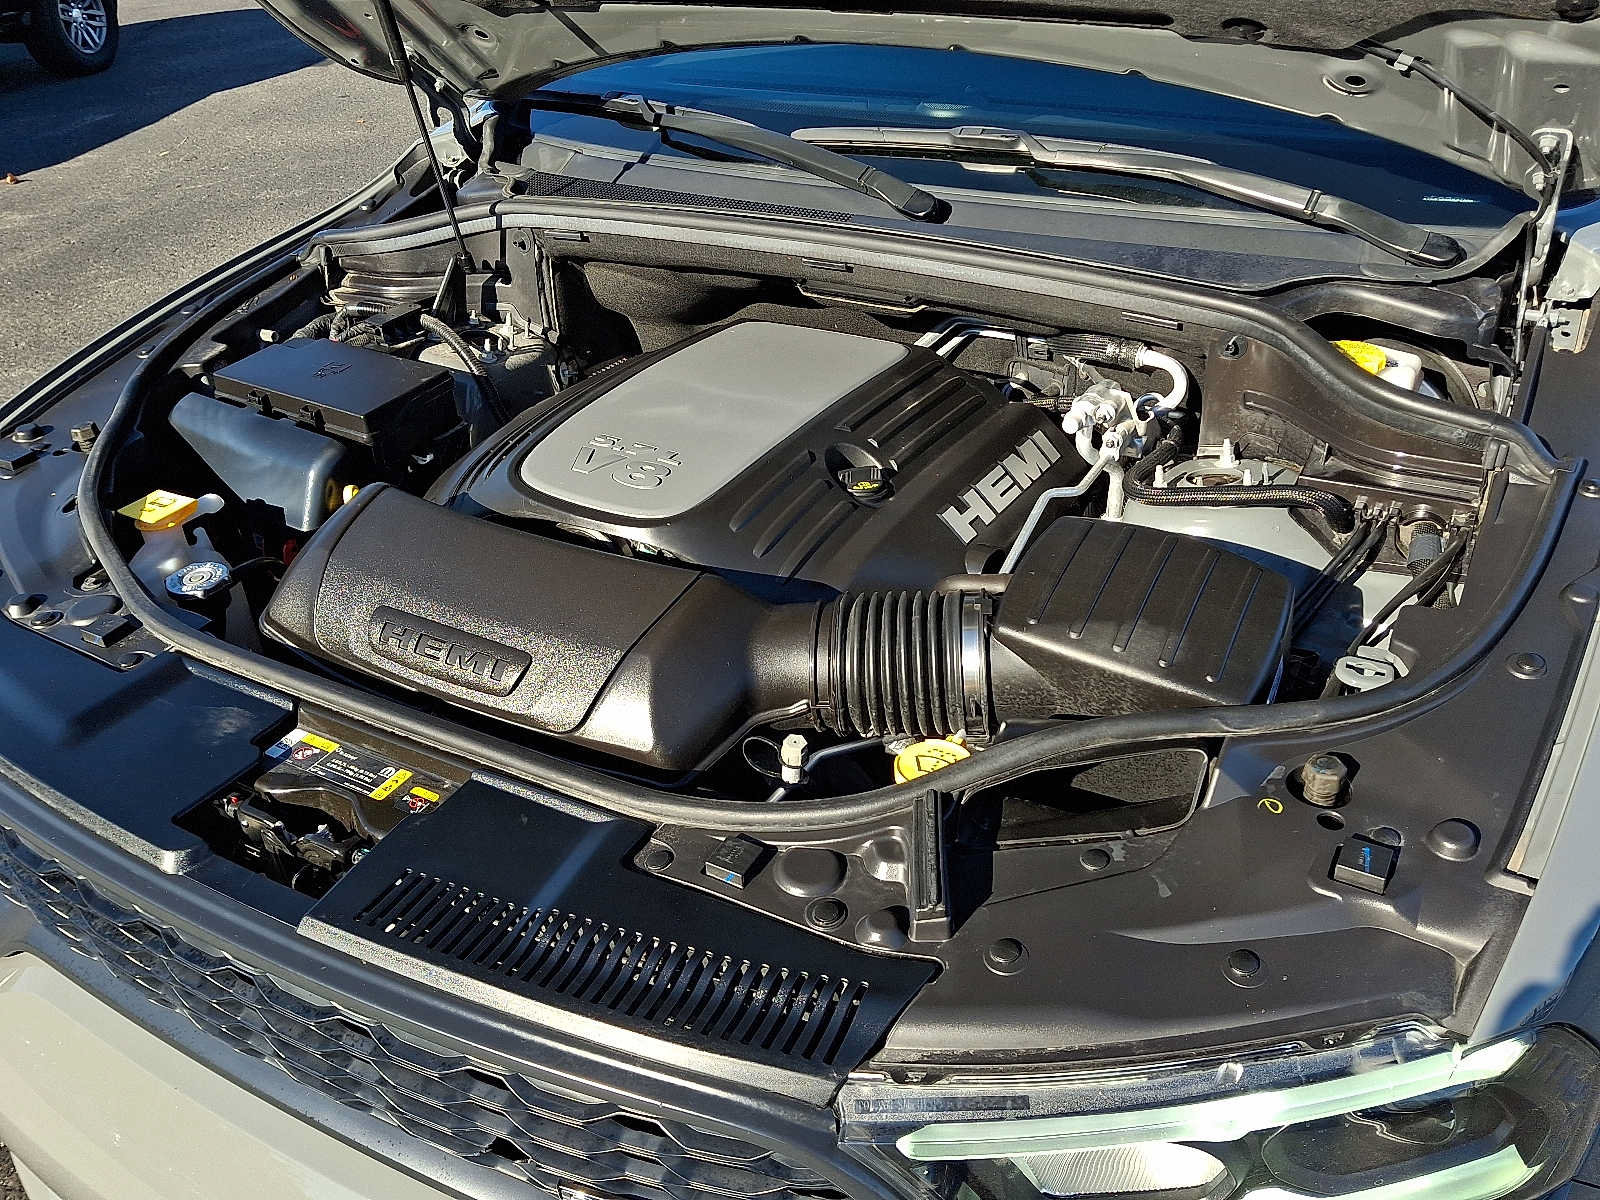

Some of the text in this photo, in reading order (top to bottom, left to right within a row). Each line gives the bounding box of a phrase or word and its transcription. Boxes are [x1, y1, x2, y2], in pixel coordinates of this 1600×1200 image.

[570, 445, 672, 490] V8
[936, 429, 1062, 545] HEMI
[379, 621, 506, 682] HEMI
